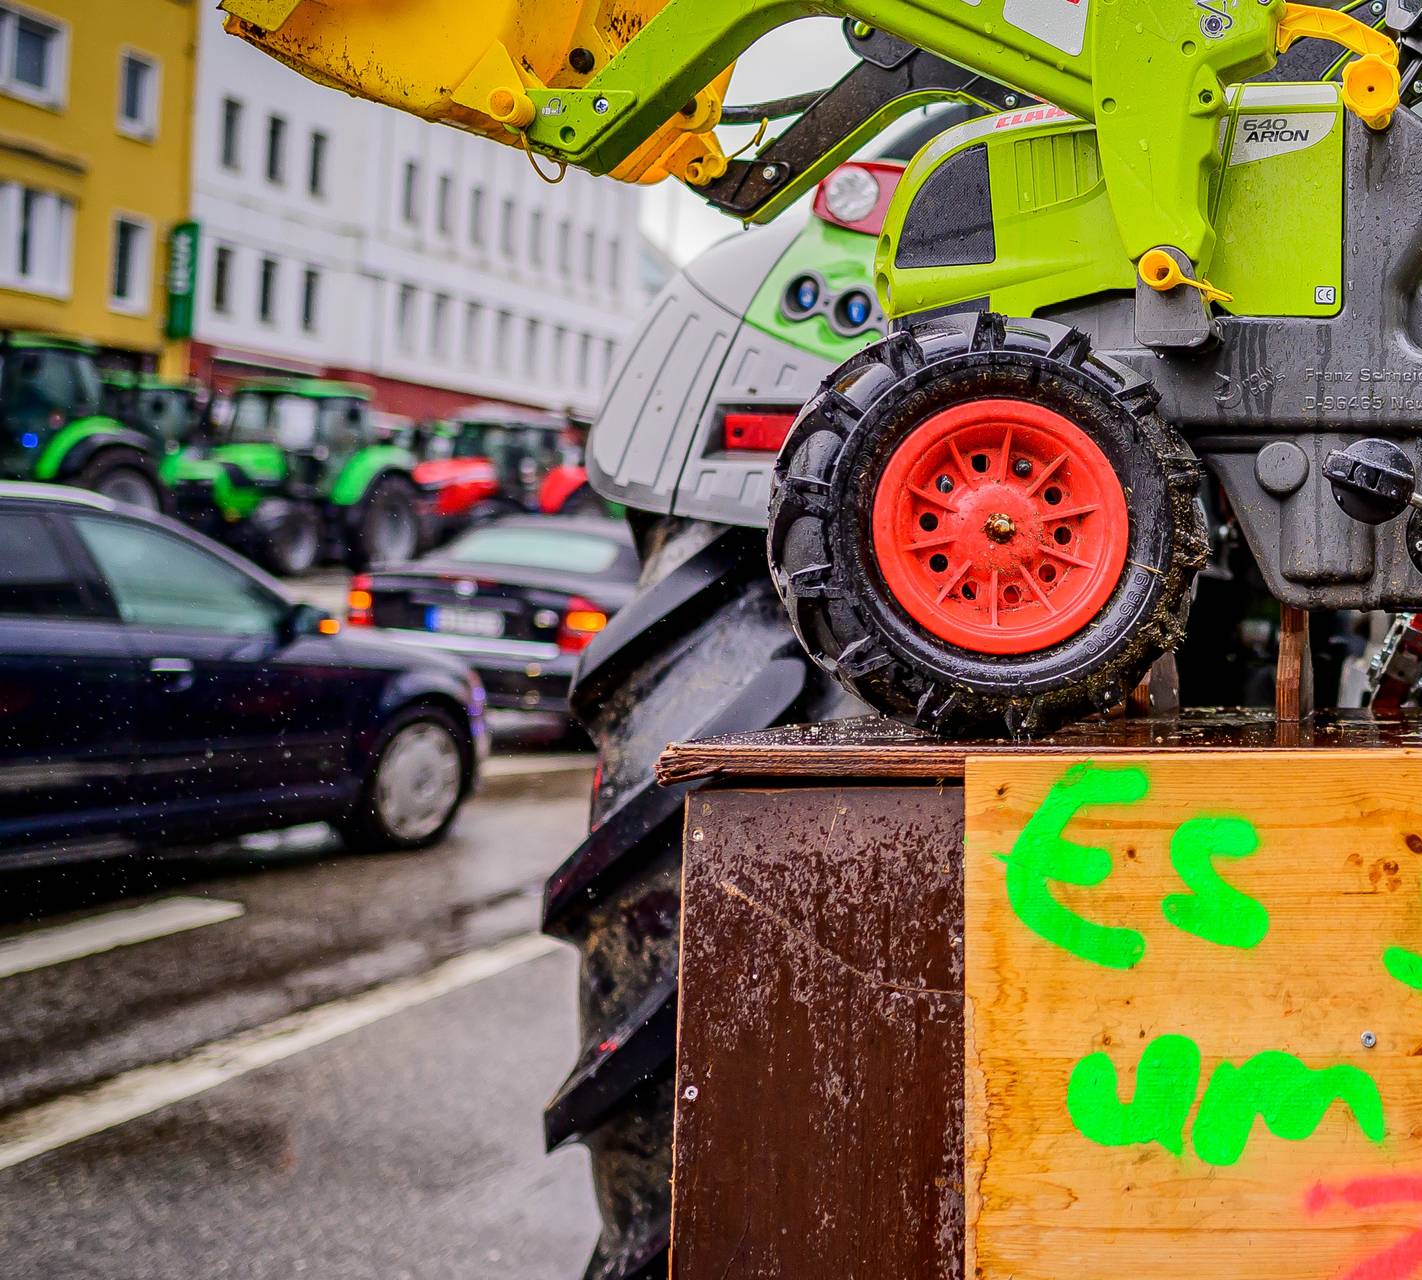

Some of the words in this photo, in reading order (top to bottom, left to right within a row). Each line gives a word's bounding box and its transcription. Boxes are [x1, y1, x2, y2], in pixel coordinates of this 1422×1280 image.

[995, 105, 1068, 129] CLAA
[1243, 118, 1288, 131] 640
[1245, 129, 1309, 143] ARION
[1304, 367, 1353, 382] Franz
[993, 758, 1271, 972] Es
[1066, 1032, 1387, 1168] um
